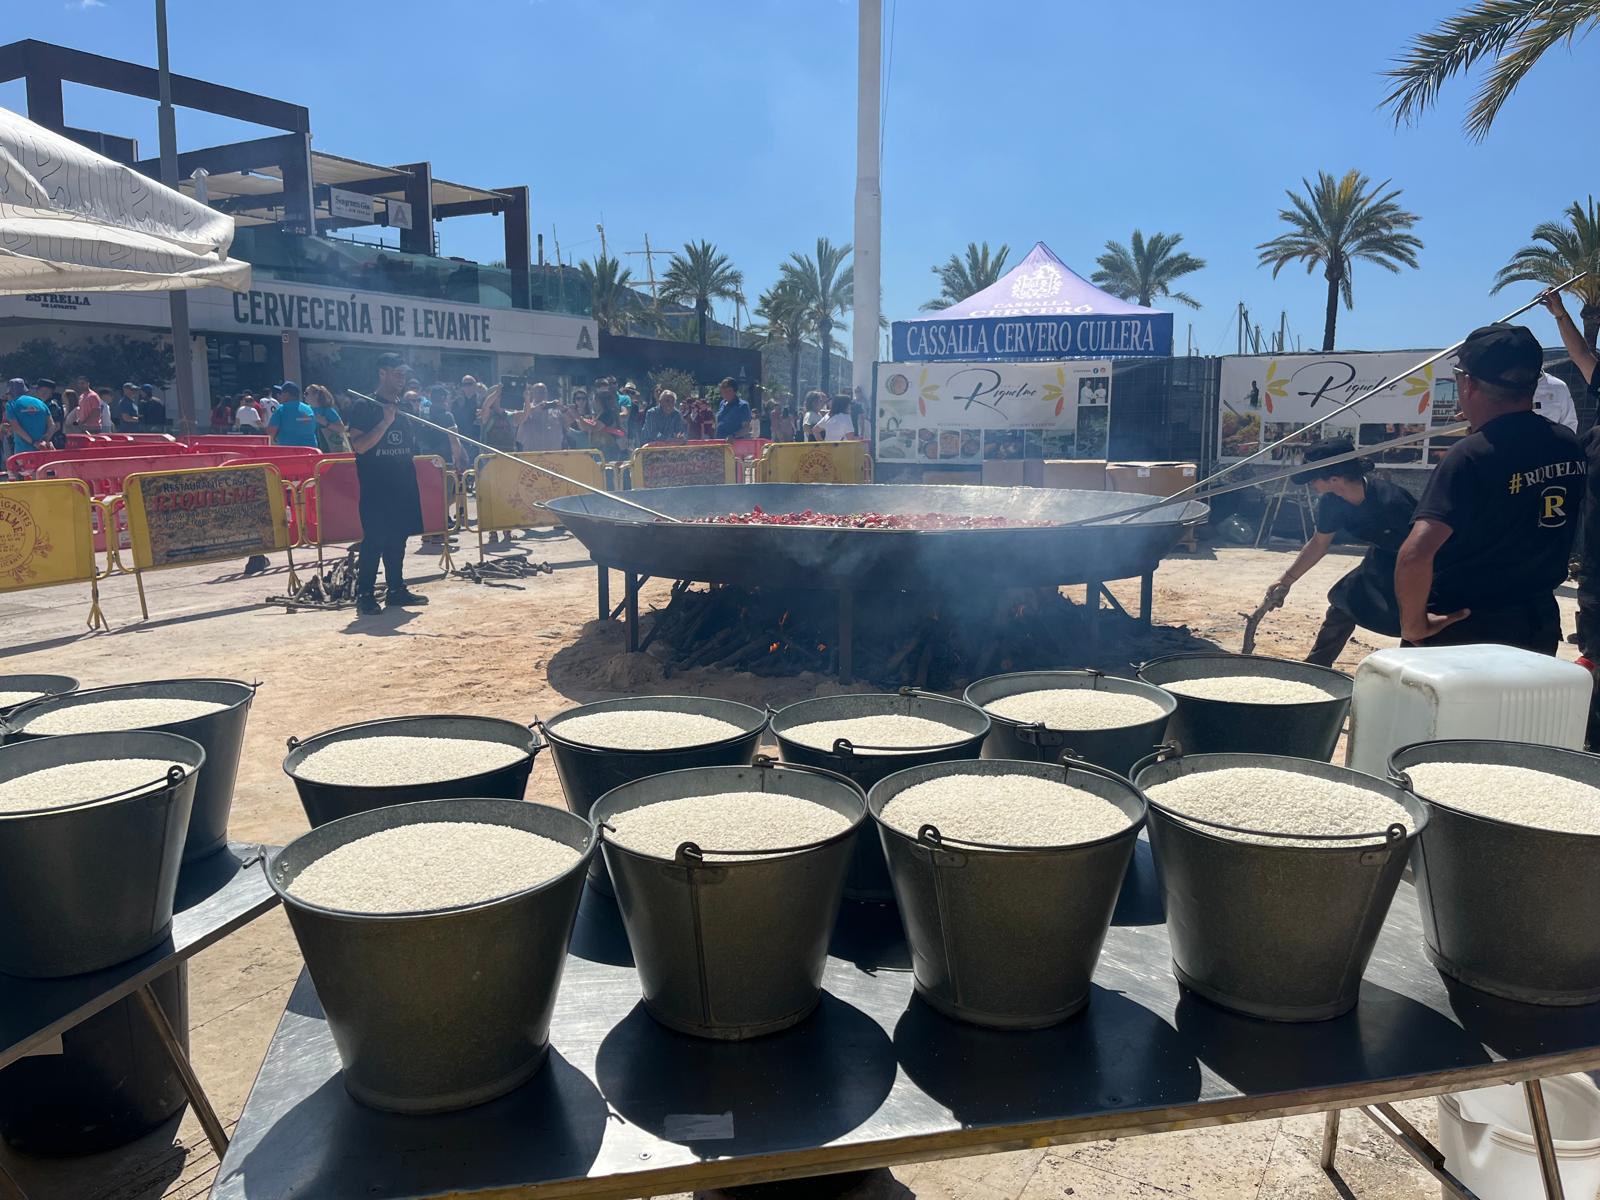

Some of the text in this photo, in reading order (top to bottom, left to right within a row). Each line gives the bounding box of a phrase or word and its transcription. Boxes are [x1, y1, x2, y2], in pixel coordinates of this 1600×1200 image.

[25, 294, 91, 306] ESTRELLA
[969, 304, 1093, 317] CERVERÓ
[994, 300, 1071, 309] CASSALLA
[233, 290, 491, 343] CERVECERÍA DE LEVANTE
[907, 319, 1155, 356] CASSALLA CERVERO CULLERA
[945, 368, 1037, 420] Riquelme
[1290, 361, 1398, 418] Riquele
[163, 479, 224, 492] RESTAURANTE
[1508, 461, 1586, 495] #RIQUELM
[152, 486, 257, 512] RIQUELME
[1542, 495, 1567, 519] R
[0, 500, 32, 527] IGANTES
